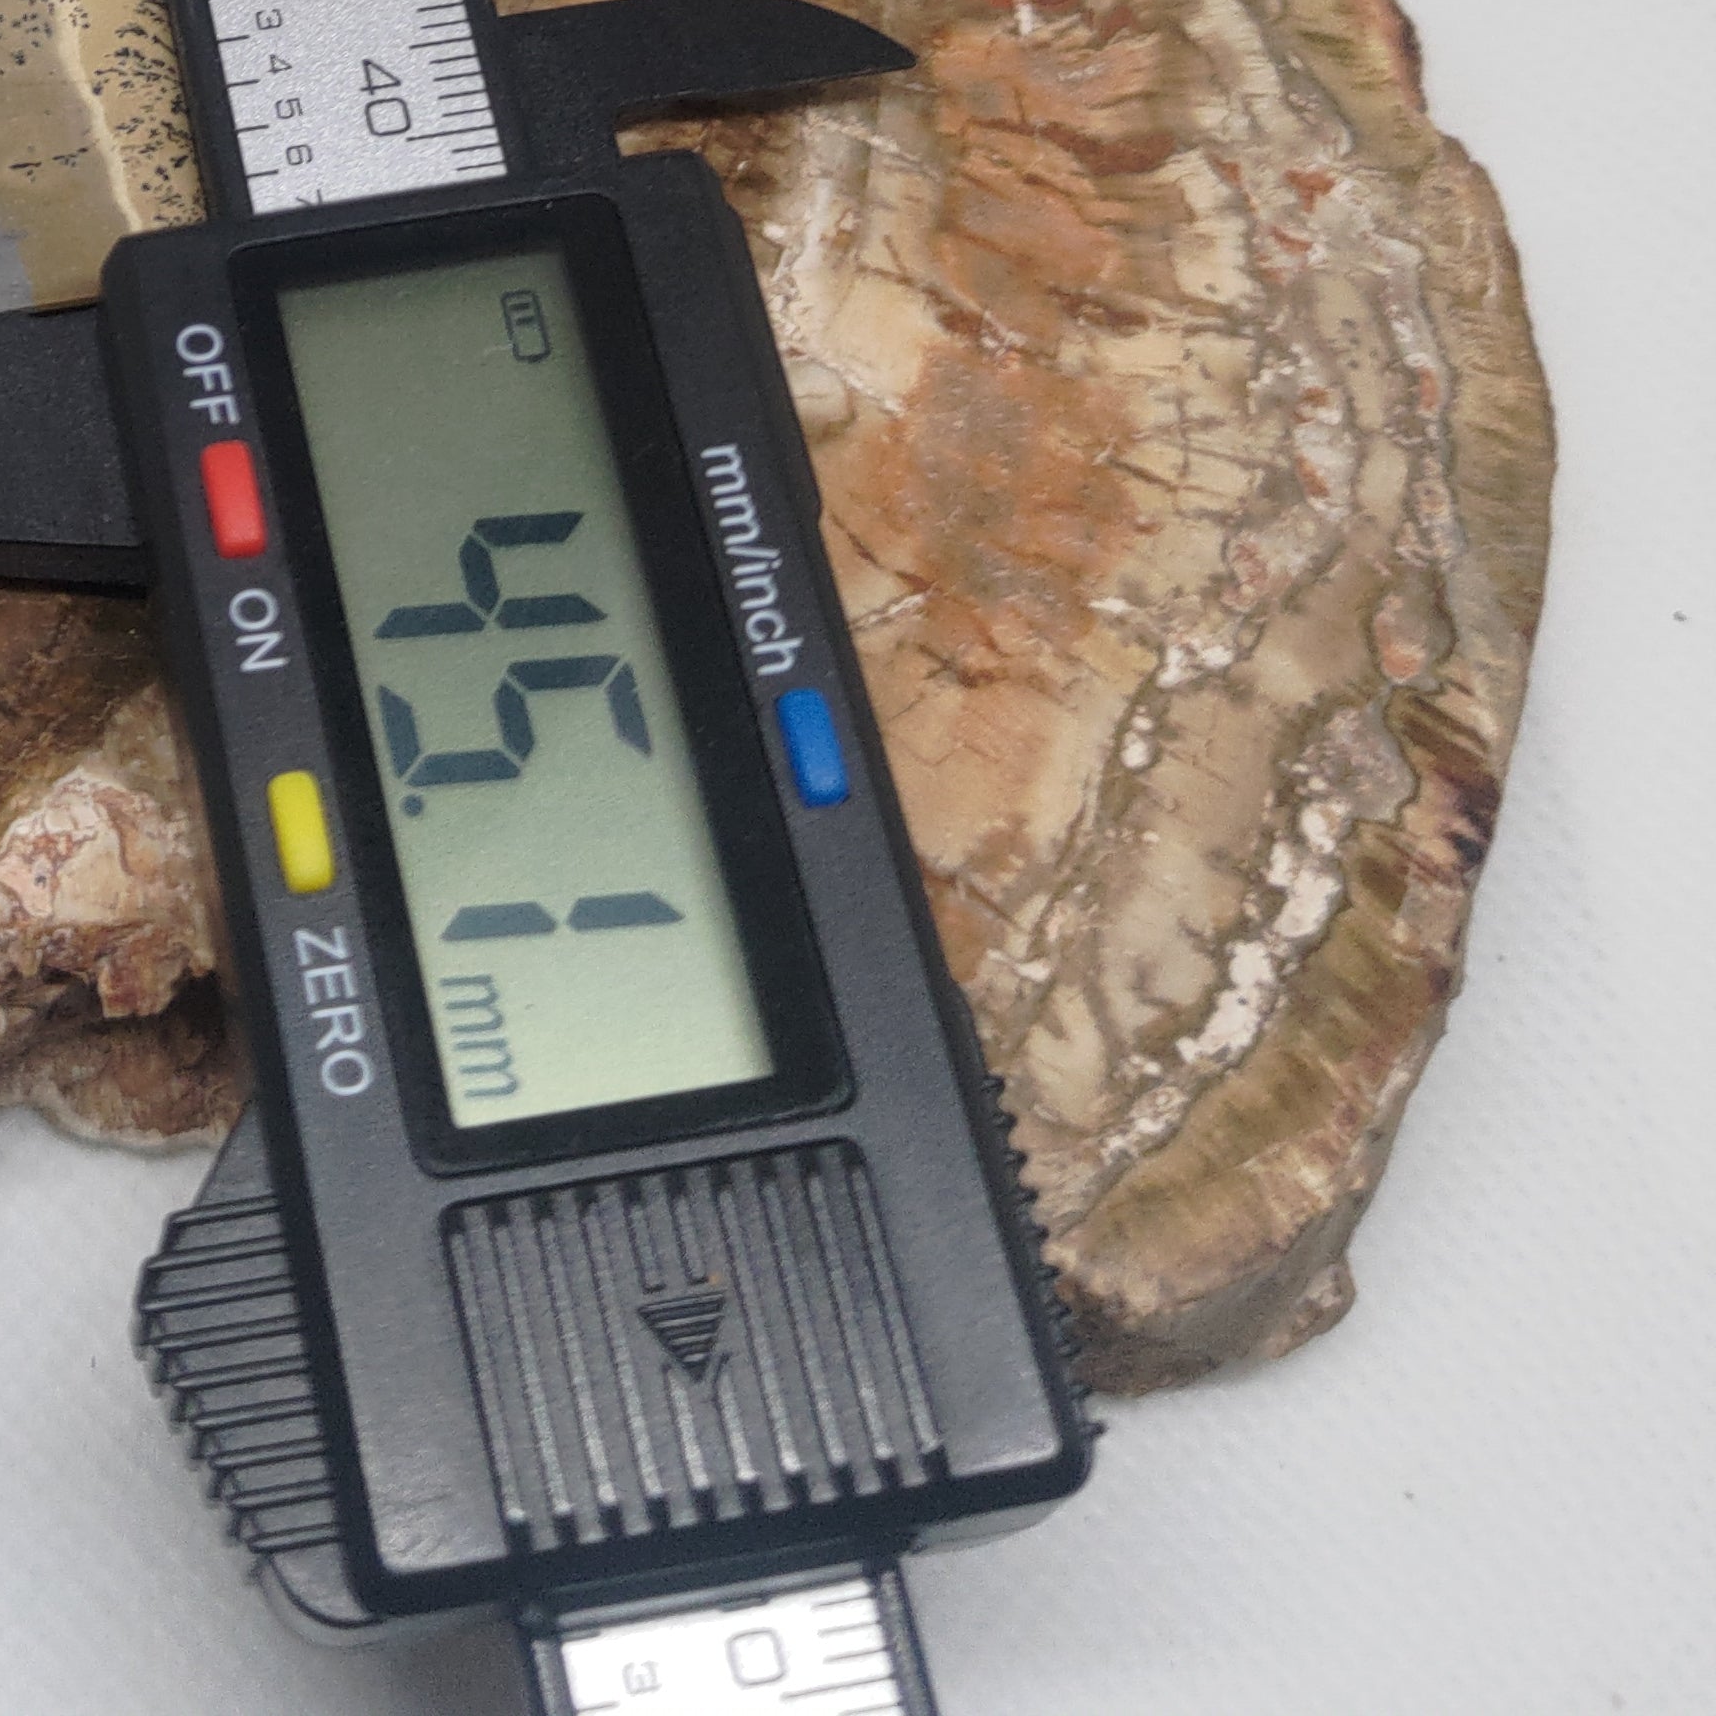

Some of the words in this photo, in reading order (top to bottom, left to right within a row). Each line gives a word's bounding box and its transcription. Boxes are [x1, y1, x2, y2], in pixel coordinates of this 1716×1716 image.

[255, 8, 282, 30] 3
[267, 54, 293, 74] 4
[360, 58, 412, 137] 40
[275, 97, 304, 120] 5
[285, 144, 313, 166] 6
[175, 323, 241, 427] OFF
[700, 442, 805, 678] mm/inch
[227, 587, 290, 673] ON
[294, 926, 373, 1098] ZERO
[439, 972, 519, 1100] mm
